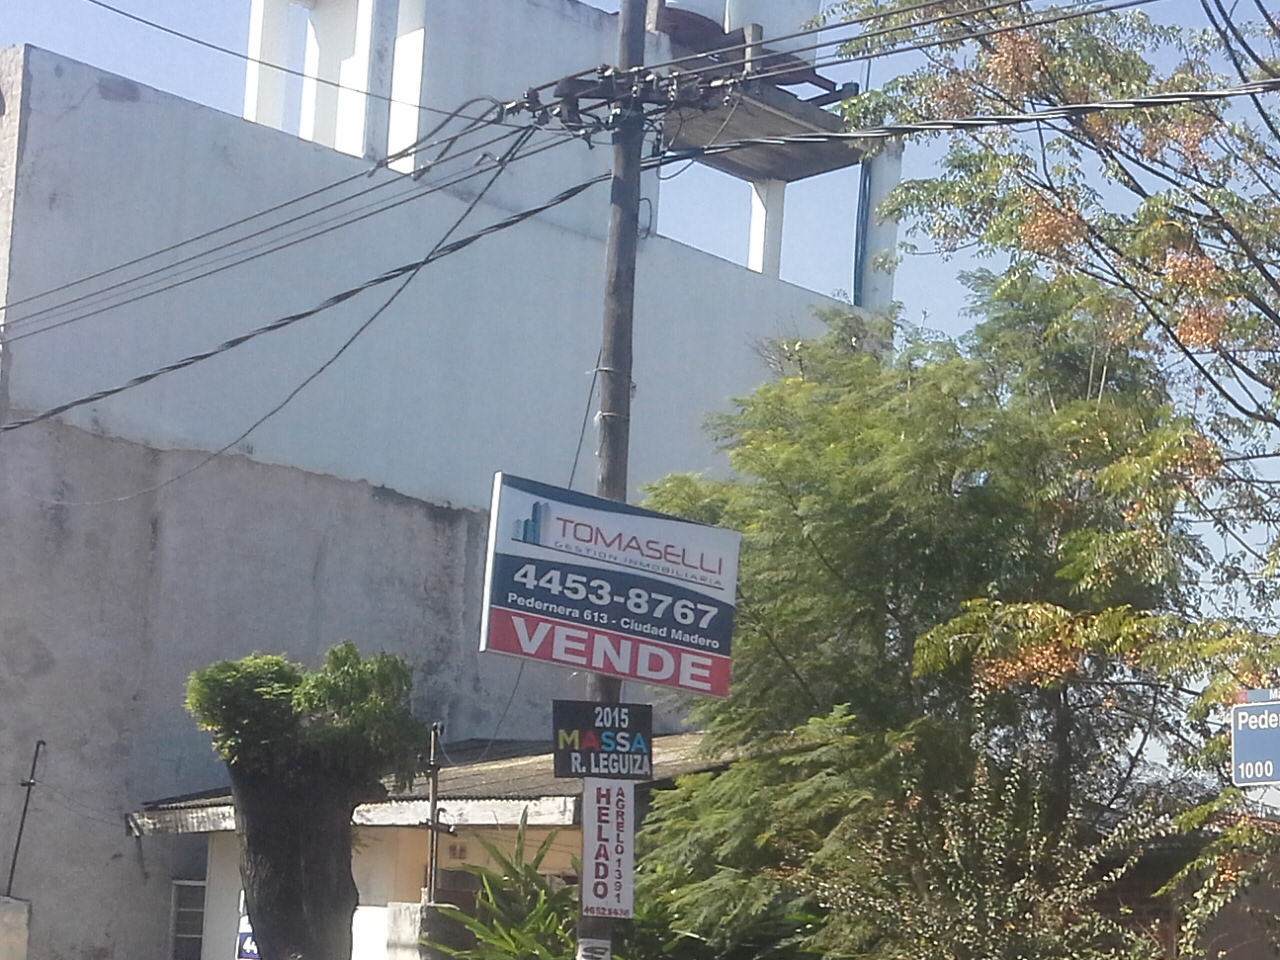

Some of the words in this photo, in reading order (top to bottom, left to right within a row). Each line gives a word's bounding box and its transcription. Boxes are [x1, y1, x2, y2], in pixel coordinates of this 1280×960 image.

[554, 541, 618, 561] GESTION
[623, 557, 723, 586] INMOBILIARIA
[556, 517, 723, 576] TOMASELLI
[507, 592, 579, 618] Pedernera
[583, 609, 608, 624] 613
[620, 617, 667, 637] Ciudad
[670, 629, 720, 649] Madero
[513, 564, 718, 628] 4453-8767
[511, 615, 713, 690] VENDE
[558, 729, 648, 753] MASSA
[594, 706, 629, 728] 2015
[571, 752, 587, 773] R.
[591, 753, 650, 775] LEGUIZA
[1238, 761, 1273, 779] 1000
[593, 787, 611, 899] HELADO
[614, 787, 625, 855] AGRELO
[613, 858, 623, 903] 1391
